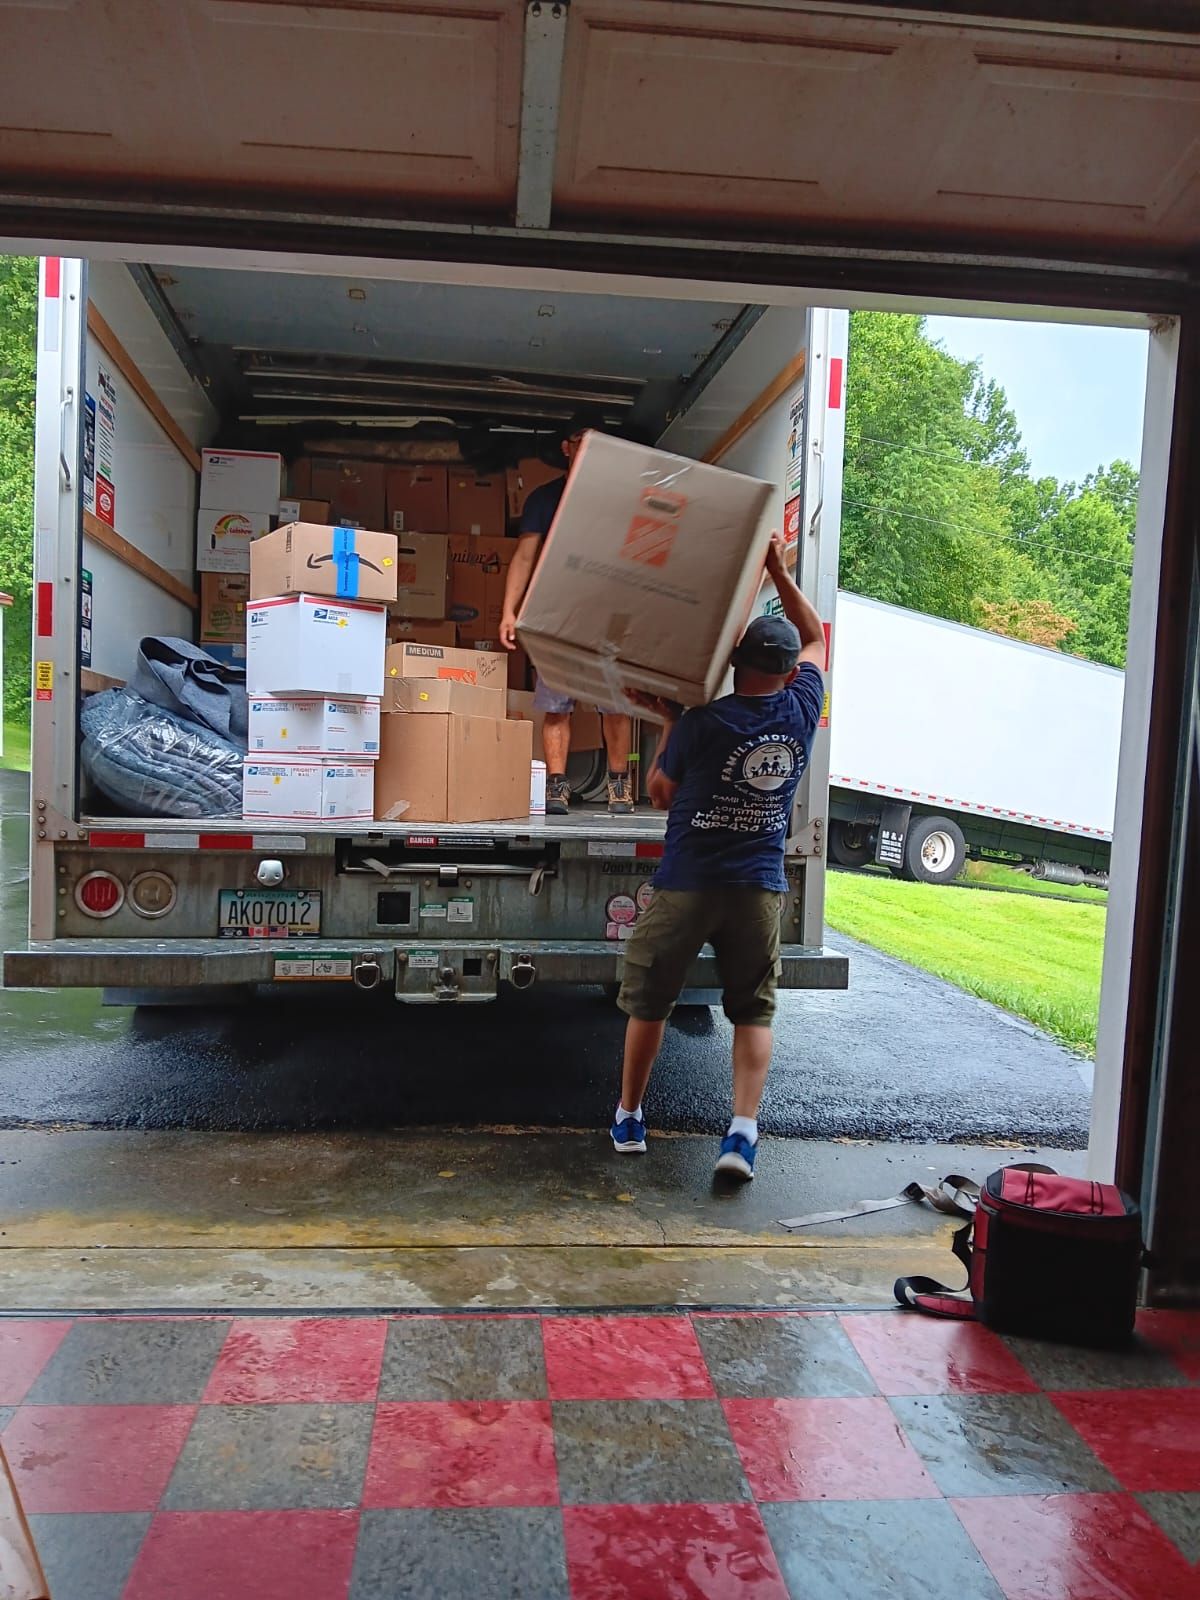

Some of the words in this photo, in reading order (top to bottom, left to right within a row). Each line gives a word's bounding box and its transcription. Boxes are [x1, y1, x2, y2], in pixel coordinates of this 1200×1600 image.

[408, 647, 442, 657] MEDIUM
[721, 740, 756, 781] FAMILY
[758, 734, 804, 754] MOVING
[228, 900, 311, 925] AK07012
